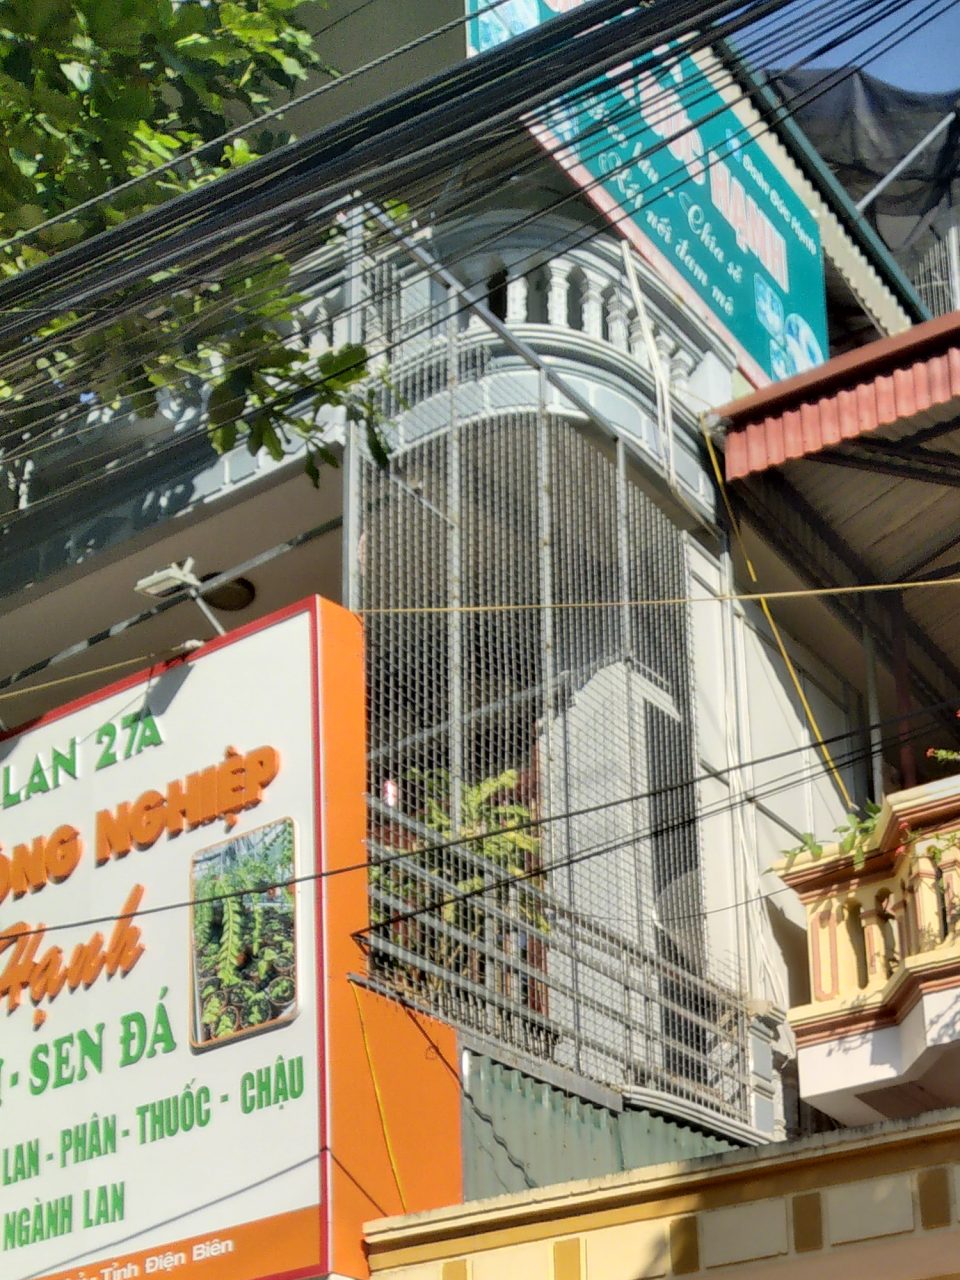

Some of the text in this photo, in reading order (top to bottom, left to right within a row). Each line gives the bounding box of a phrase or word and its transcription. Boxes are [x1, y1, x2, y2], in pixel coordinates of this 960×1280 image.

[708, 149, 789, 294] HẠNH
[2, 706, 164, 809] LAN 27A
[95, 745, 279, 868] NGHIỆP
[30, 1023, 105, 1095] SEN
[119, 986, 176, 1068] ĐÁ
[3, 1138, 40, 1185] LAN
[60, 1112, 117, 1168] PHÂN
[136, 1078, 211, 1145] THUỐC
[240, 1055, 304, 1115] CHẬU
[4, 1181, 125, 1250] NGÀNH LAN
[145, 1249, 187, 1273] Điện
[192, 1238, 234, 1262] Biên
